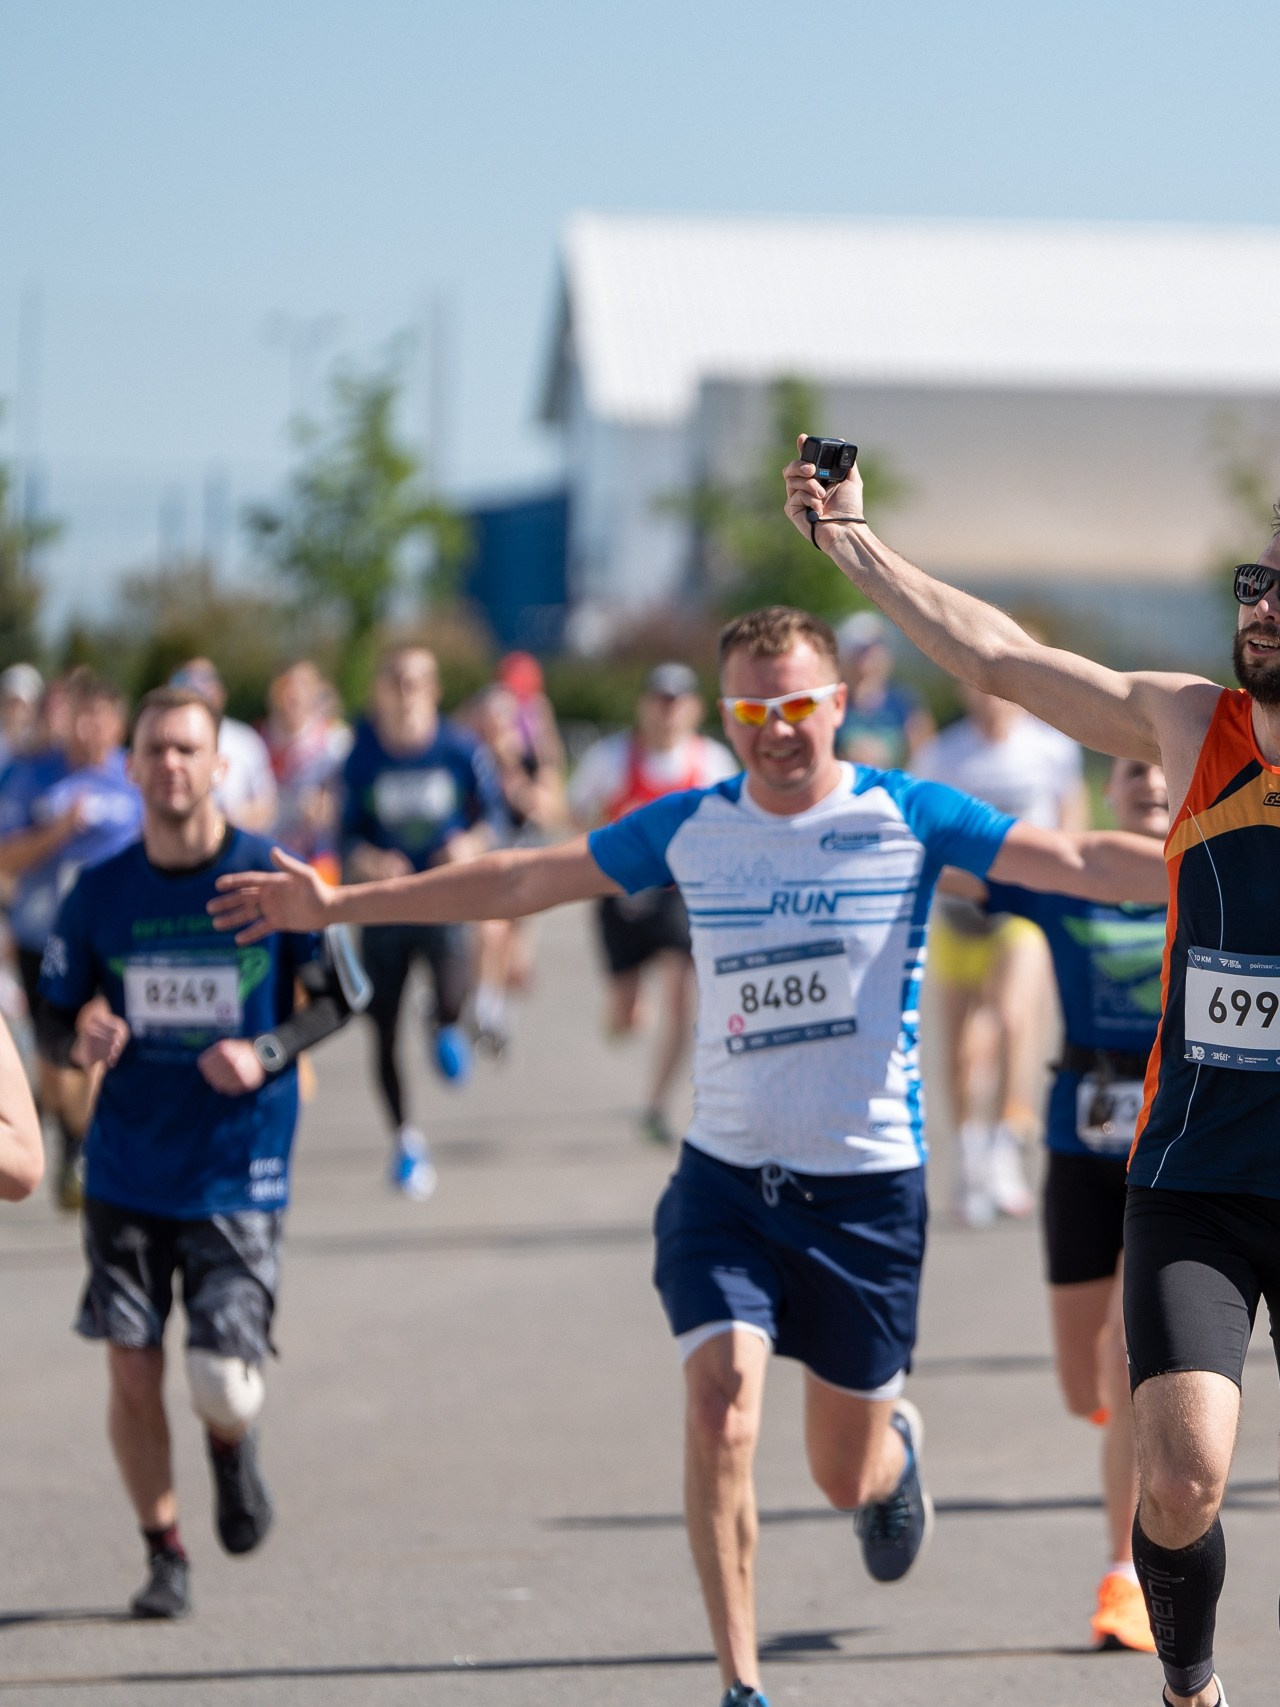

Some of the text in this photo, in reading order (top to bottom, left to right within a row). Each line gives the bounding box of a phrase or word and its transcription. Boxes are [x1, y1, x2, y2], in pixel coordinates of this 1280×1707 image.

[770, 891, 838, 915] RUN
[145, 977, 218, 1010] 8249
[740, 970, 827, 1014] 8486
